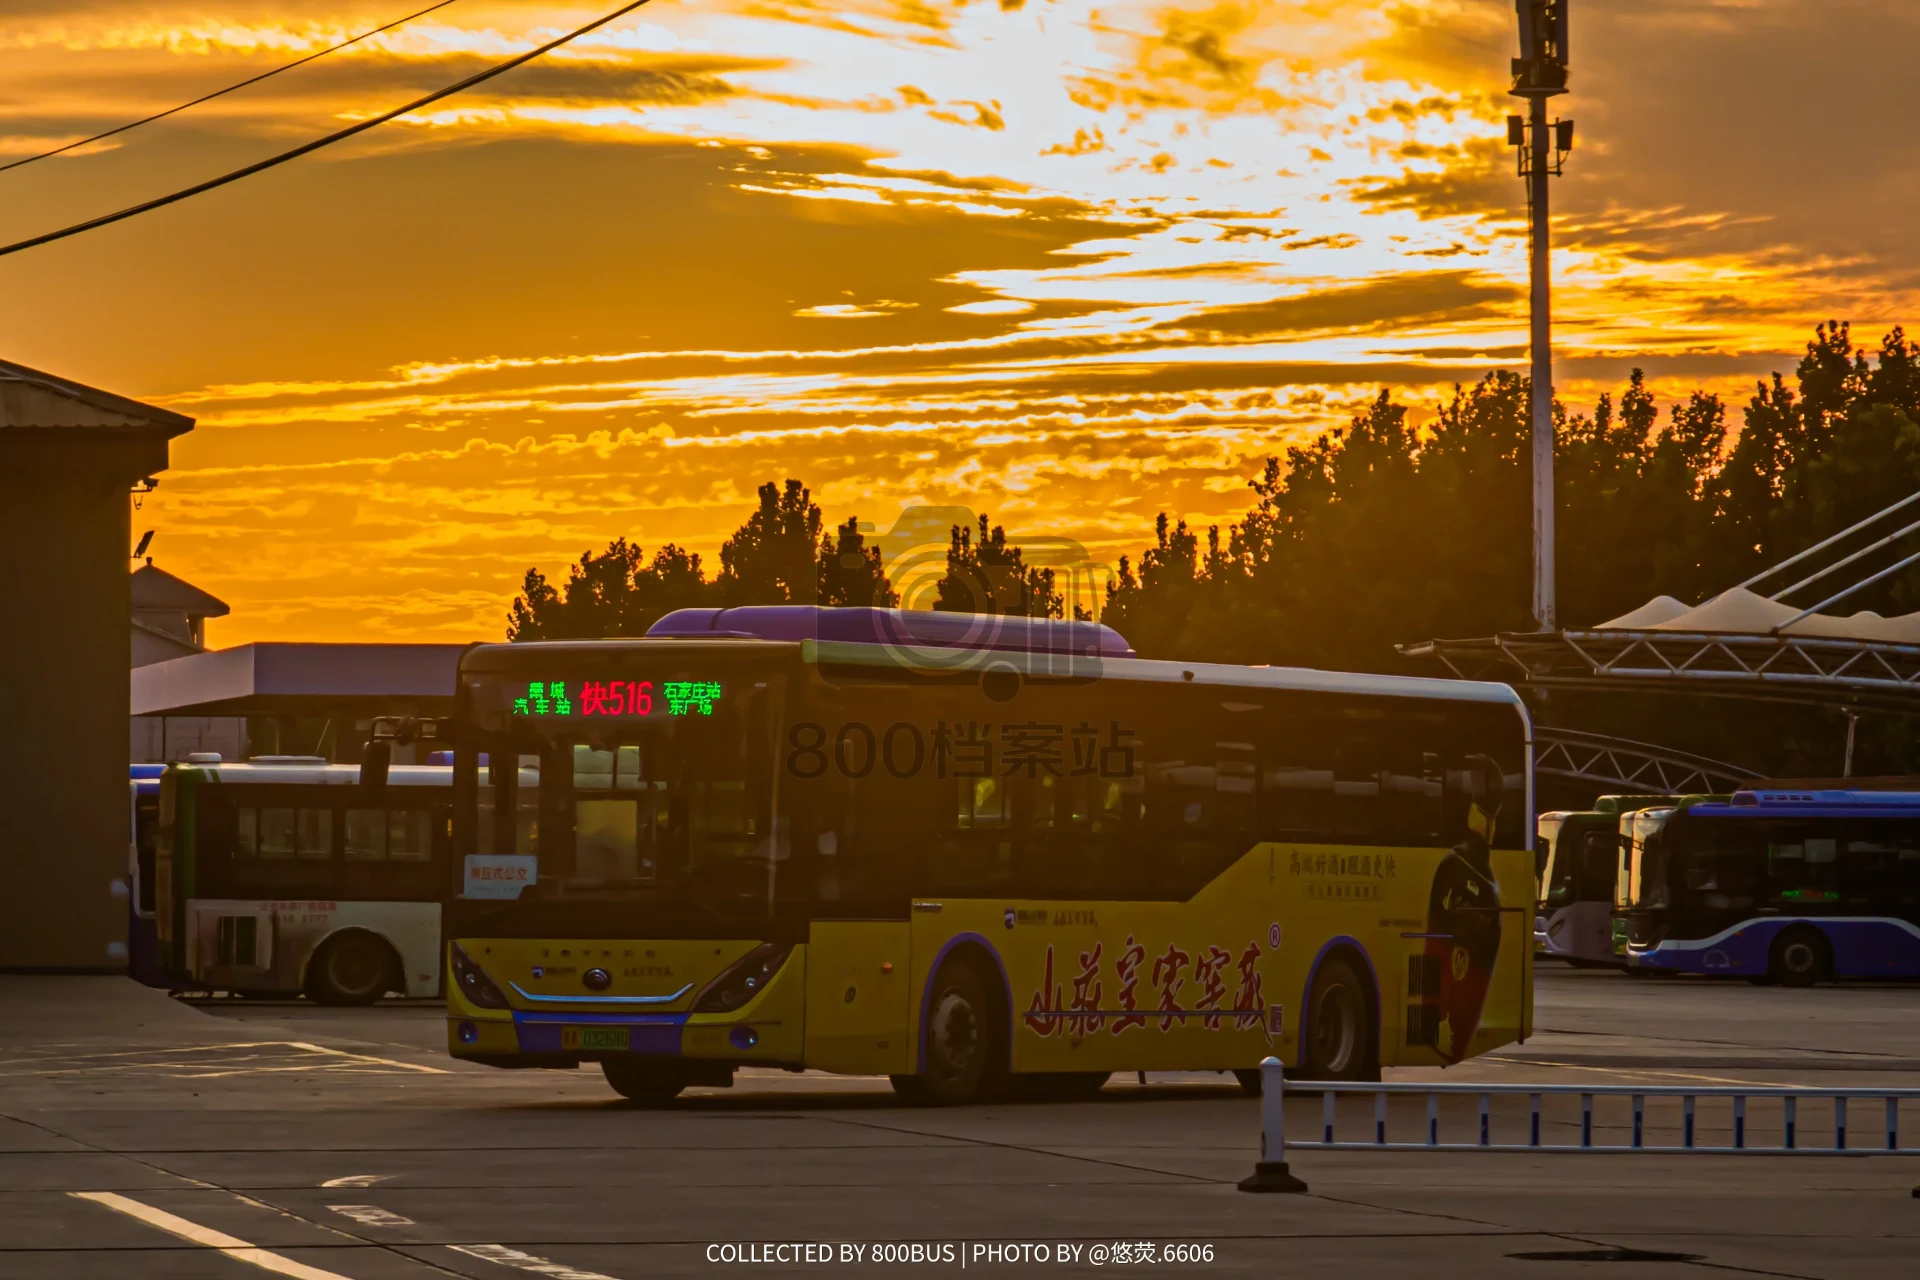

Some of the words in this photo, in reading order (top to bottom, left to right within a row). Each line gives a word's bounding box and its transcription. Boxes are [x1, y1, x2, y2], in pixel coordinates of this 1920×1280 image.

[579, 681, 653, 717] 快516
[664, 681, 721, 700] 石家庄站
[514, 698, 572, 716] 汽车站
[669, 699, 713, 716] 东广场
